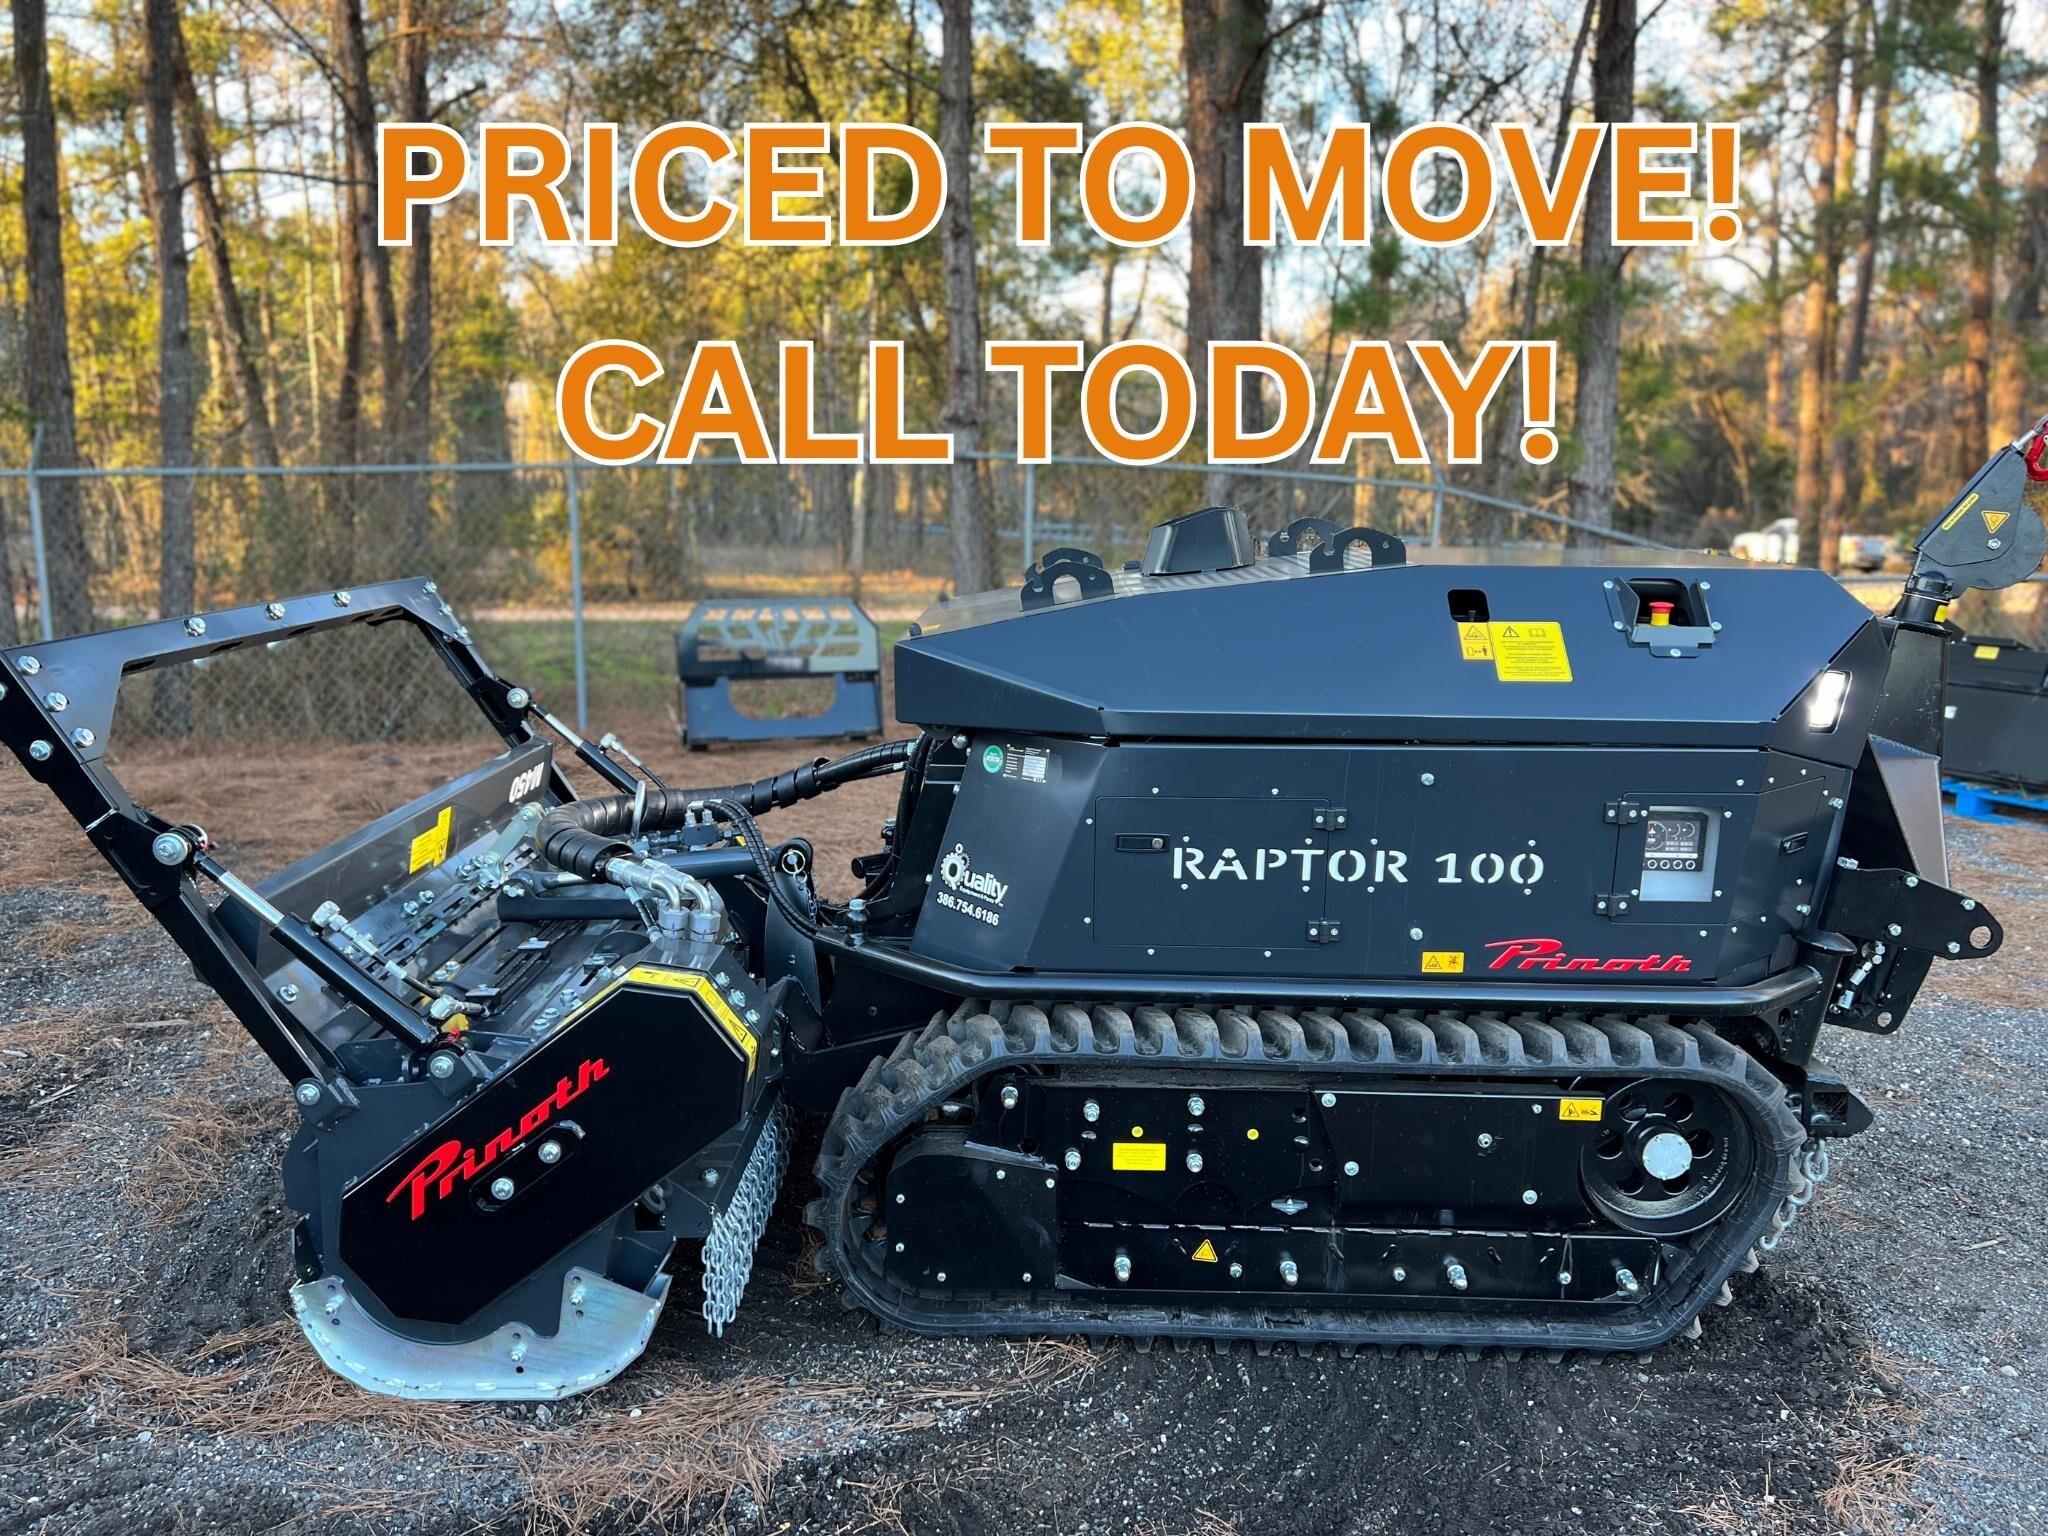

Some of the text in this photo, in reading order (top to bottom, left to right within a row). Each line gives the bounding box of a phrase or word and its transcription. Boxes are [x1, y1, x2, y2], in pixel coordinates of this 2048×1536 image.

[942, 853, 1009, 905] Quality
[1173, 847, 1544, 884] RAPTOR 100
[937, 891, 1000, 926] 386.754.6186
[1484, 938, 1692, 972] Prinoth
[386, 1058, 610, 1221] Prinoth
